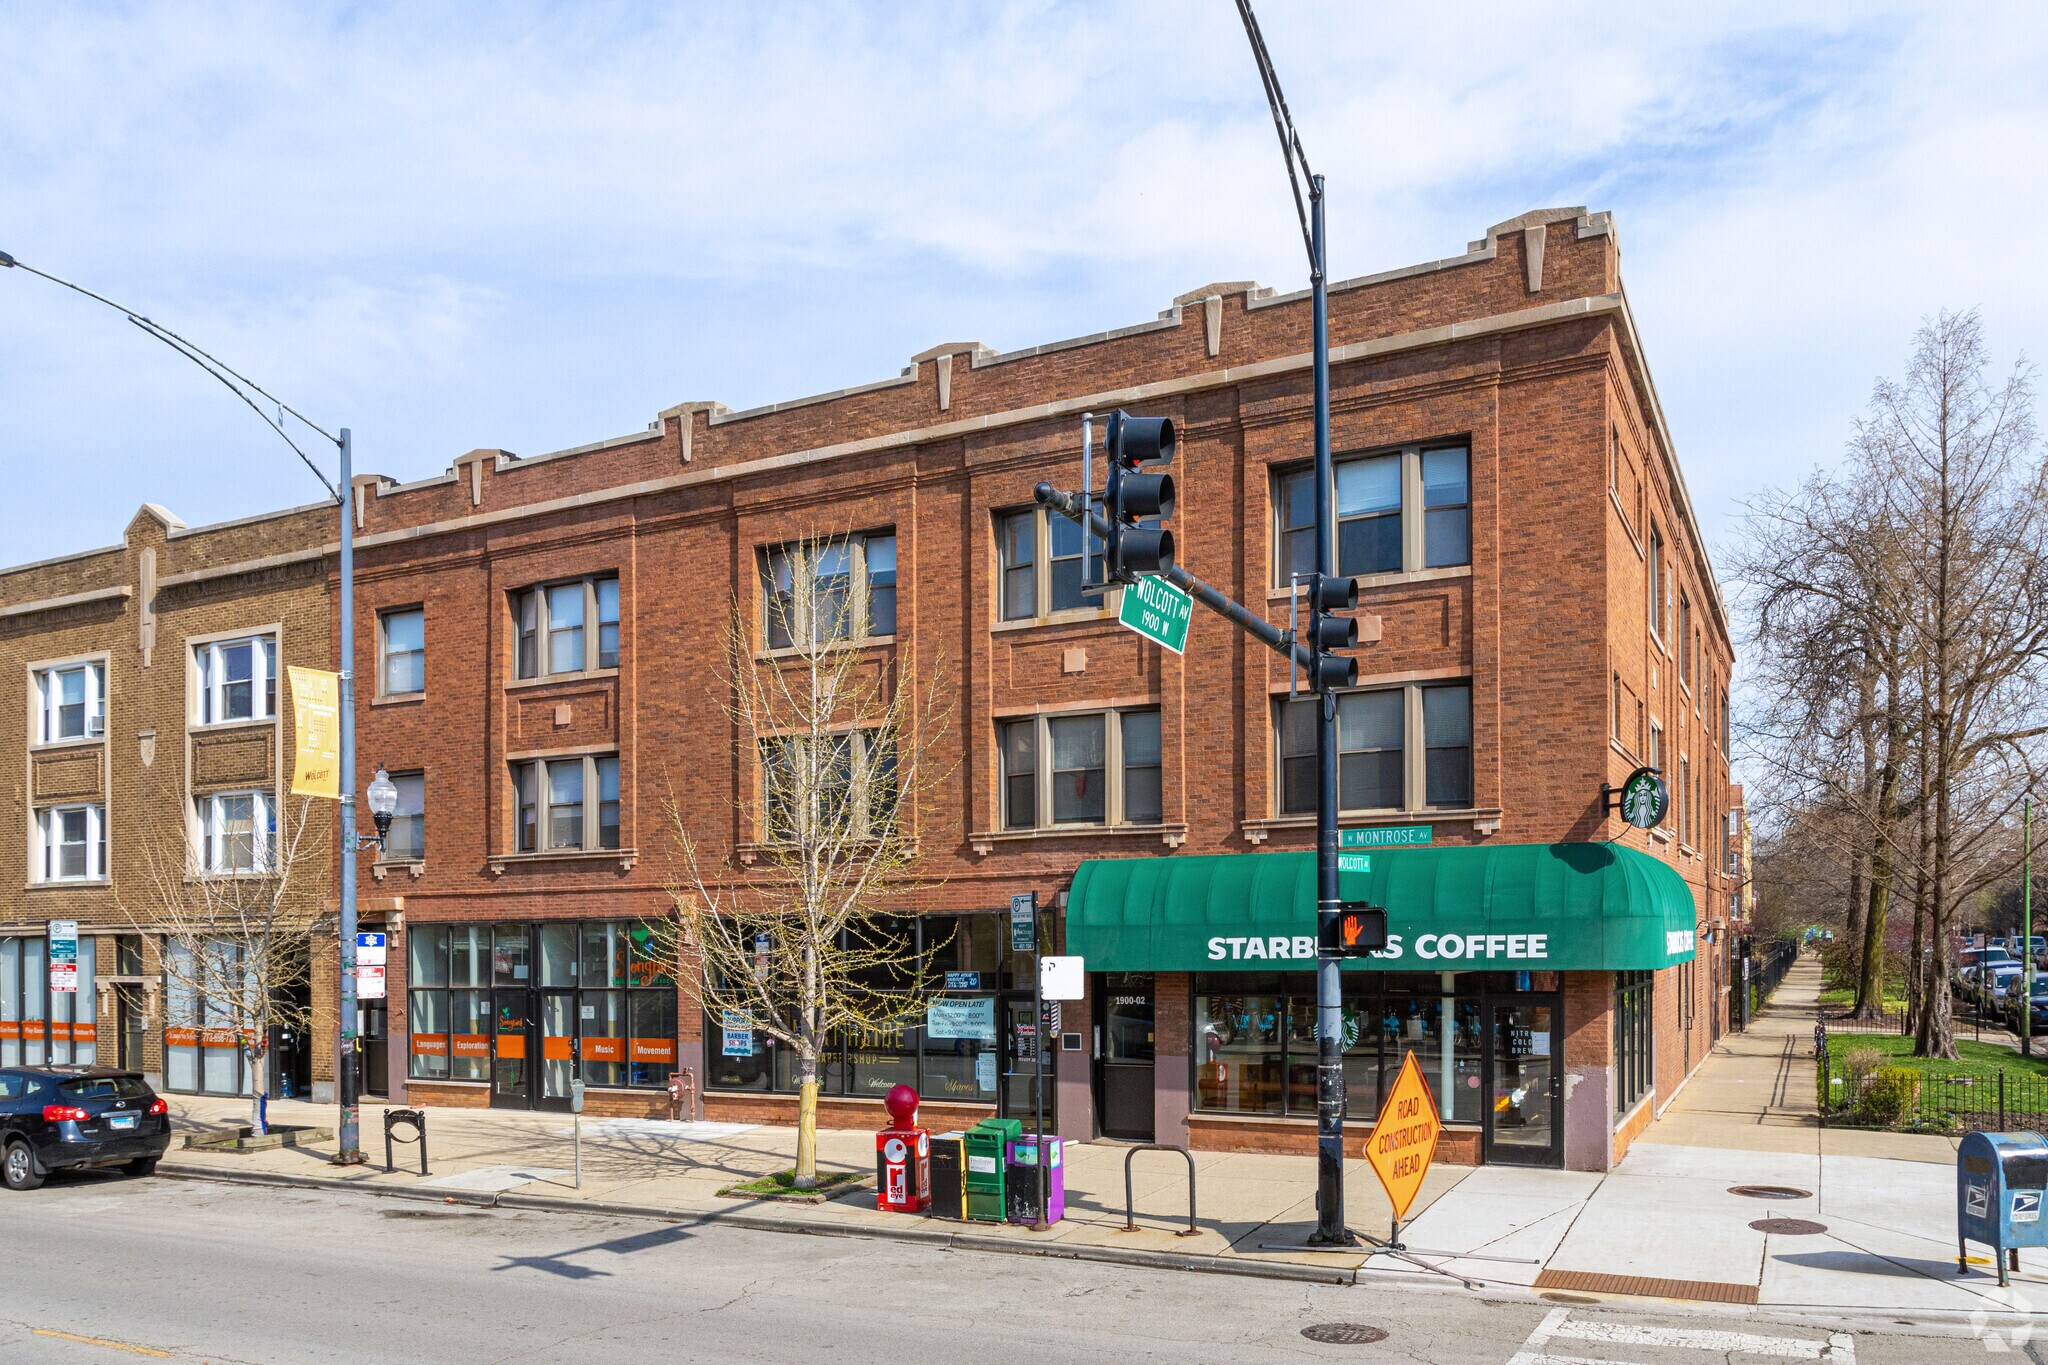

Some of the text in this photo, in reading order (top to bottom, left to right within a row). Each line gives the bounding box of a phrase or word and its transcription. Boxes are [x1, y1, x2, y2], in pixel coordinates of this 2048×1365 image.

[1137, 576, 1179, 619] WOLCOTT
[1179, 604, 1189, 620] AV
[1141, 609, 1170, 637] 1900 W
[1347, 829, 1428, 845] W MONTROSE AV
[1208, 934, 1548, 960] STARBS COFFEE
[968, 1000, 985, 1008] LATE!
[1115, 996, 1146, 1005] 1900-02
[416, 1040, 446, 1050] Languages
[456, 1041, 489, 1051] Exploration
[595, 1045, 614, 1054] Music
[637, 1046, 671, 1055] Movement
[1397, 1096, 1420, 1120] ROAD
[1378, 1121, 1433, 1155] CONSTRUCTION
[1391, 1153, 1421, 1181] AHEAD
